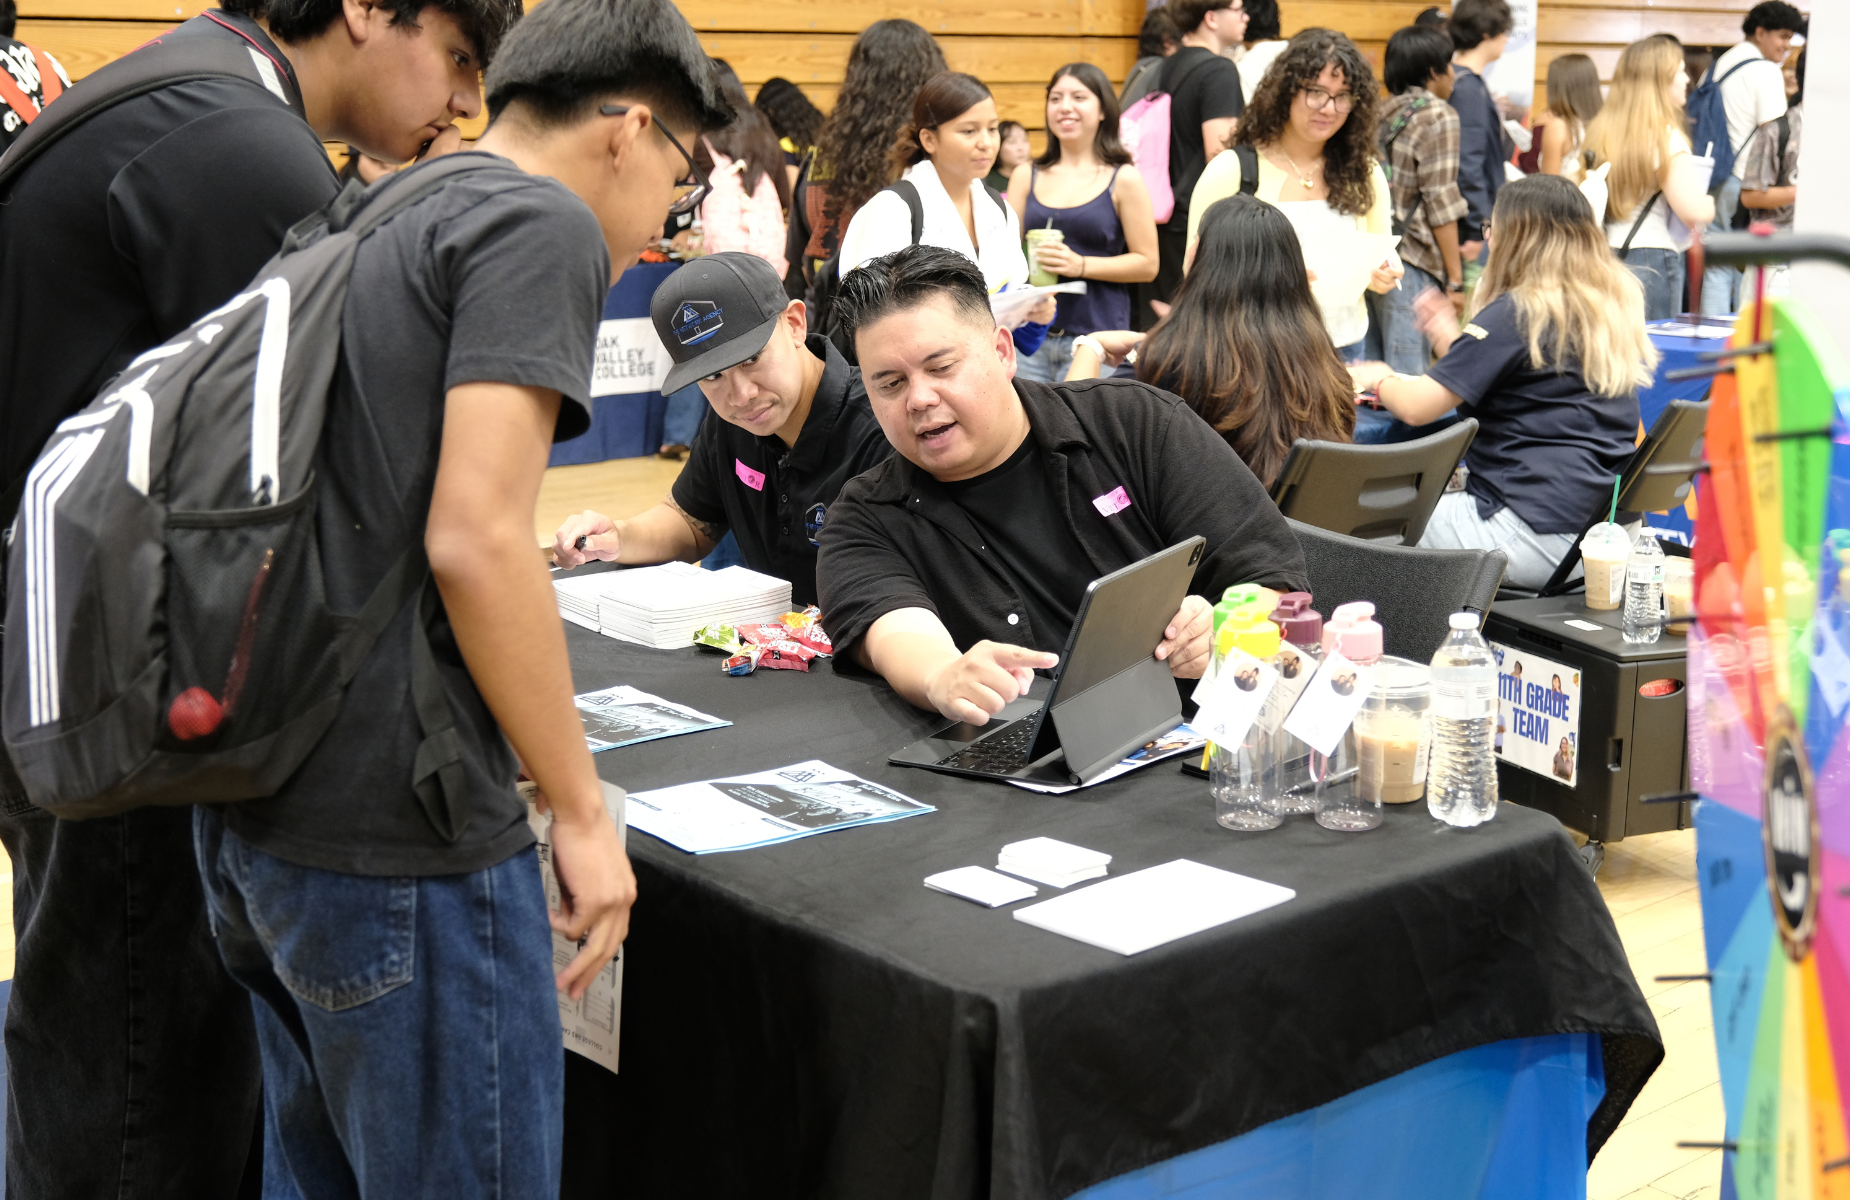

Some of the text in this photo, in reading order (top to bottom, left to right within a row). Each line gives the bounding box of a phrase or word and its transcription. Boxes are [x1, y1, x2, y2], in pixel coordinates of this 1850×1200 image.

[703, 307, 724, 322] AGENCY
[595, 347, 645, 363] VALLEY
[595, 361, 655, 380] COLLEGE
[1498, 671, 1570, 723] 11TH GRADE
[1512, 706, 1550, 746] TEAM
